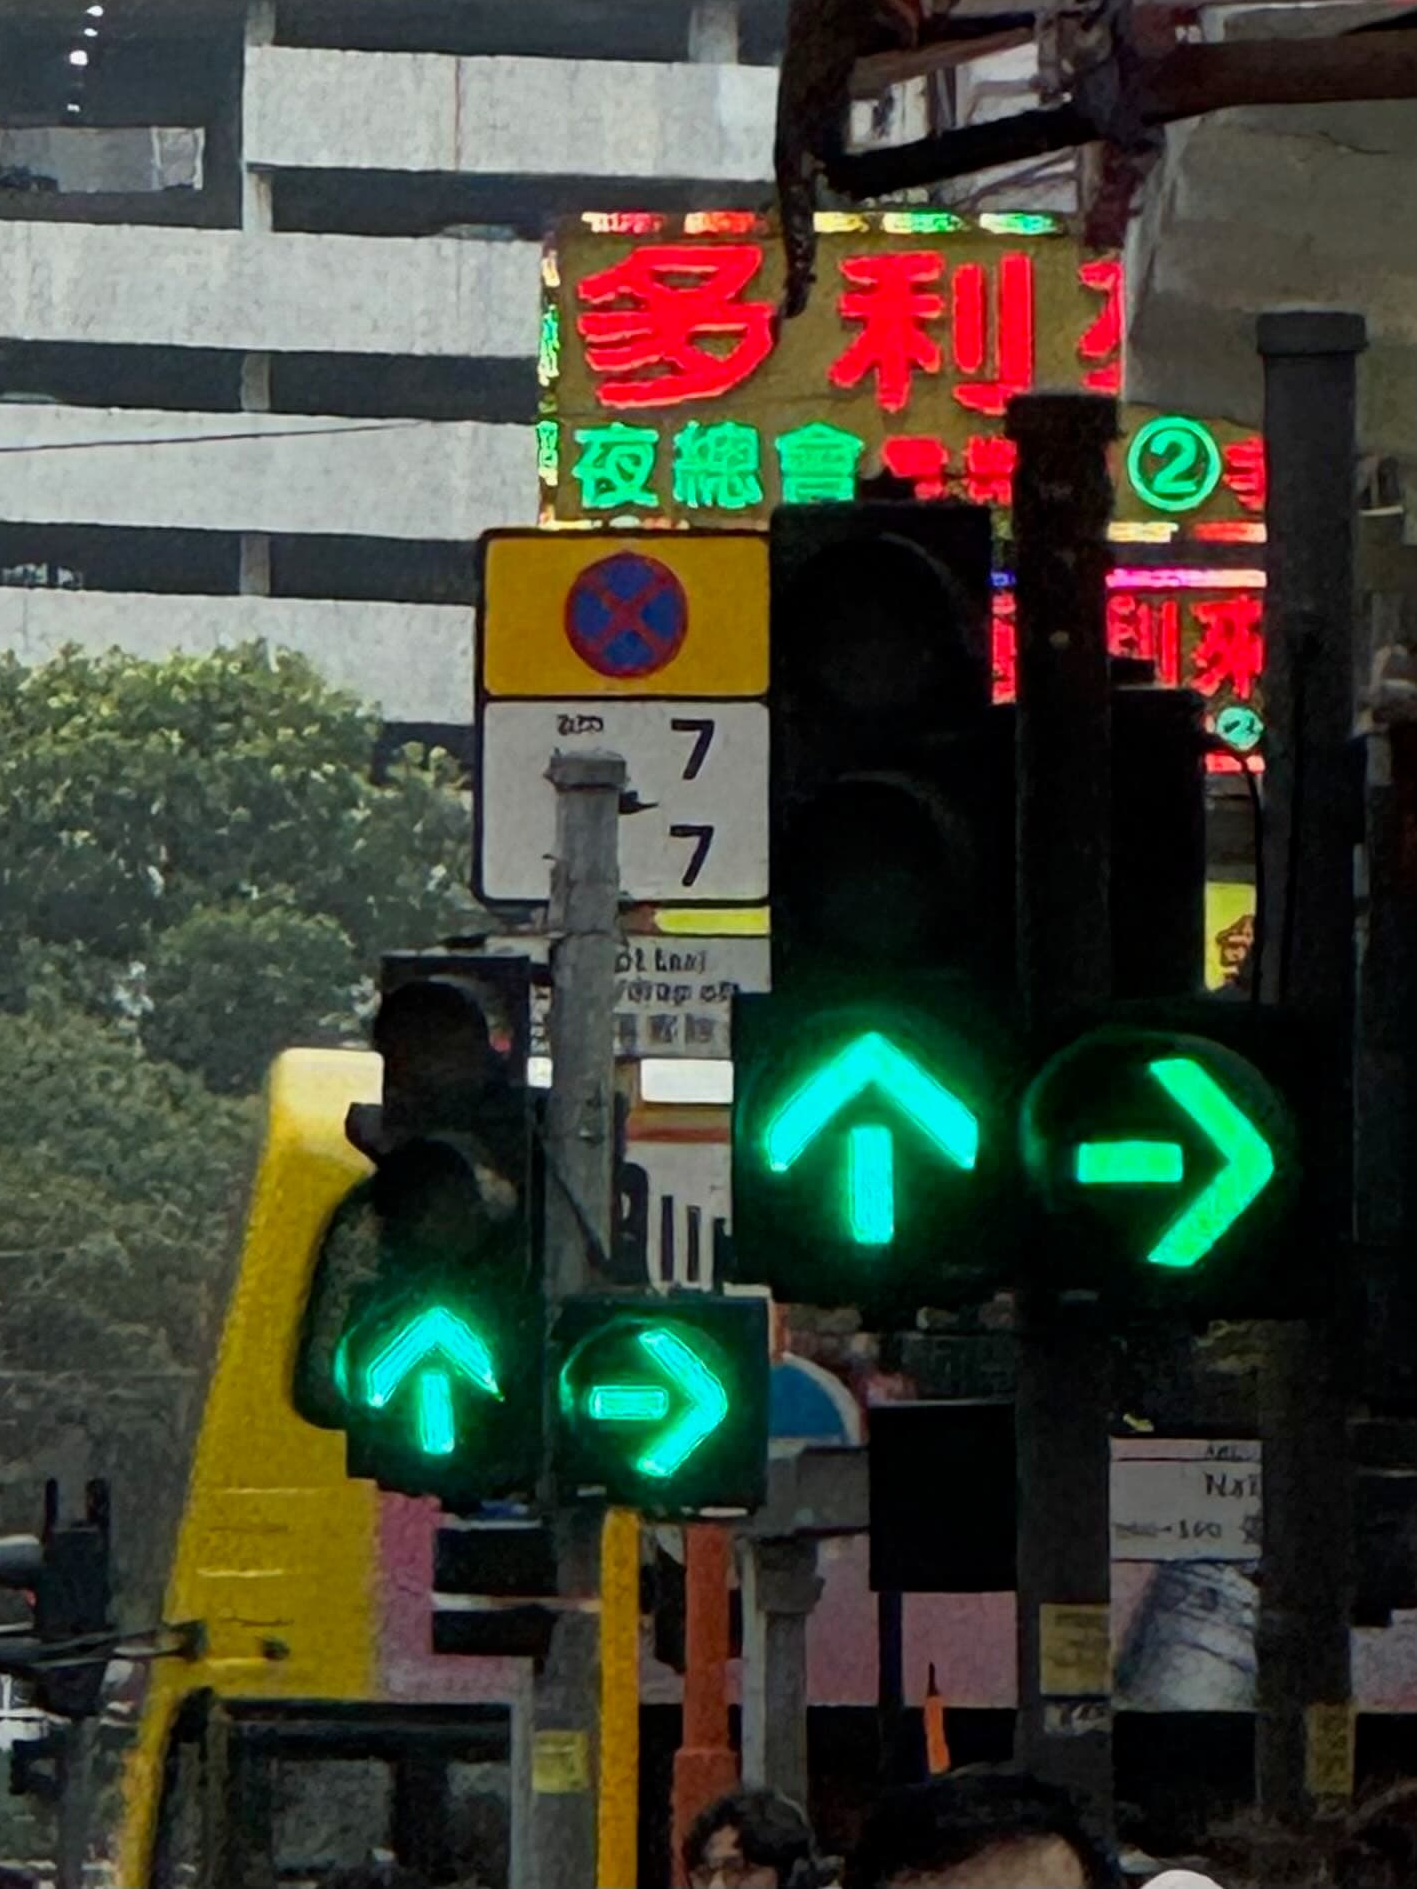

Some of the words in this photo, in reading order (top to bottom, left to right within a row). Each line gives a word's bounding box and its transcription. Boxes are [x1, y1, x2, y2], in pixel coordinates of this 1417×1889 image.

[577, 244, 1124, 415] 多利
[572, 421, 865, 510] 夜總會
[670, 718, 715, 781] 7
[669, 824, 715, 887] 7
